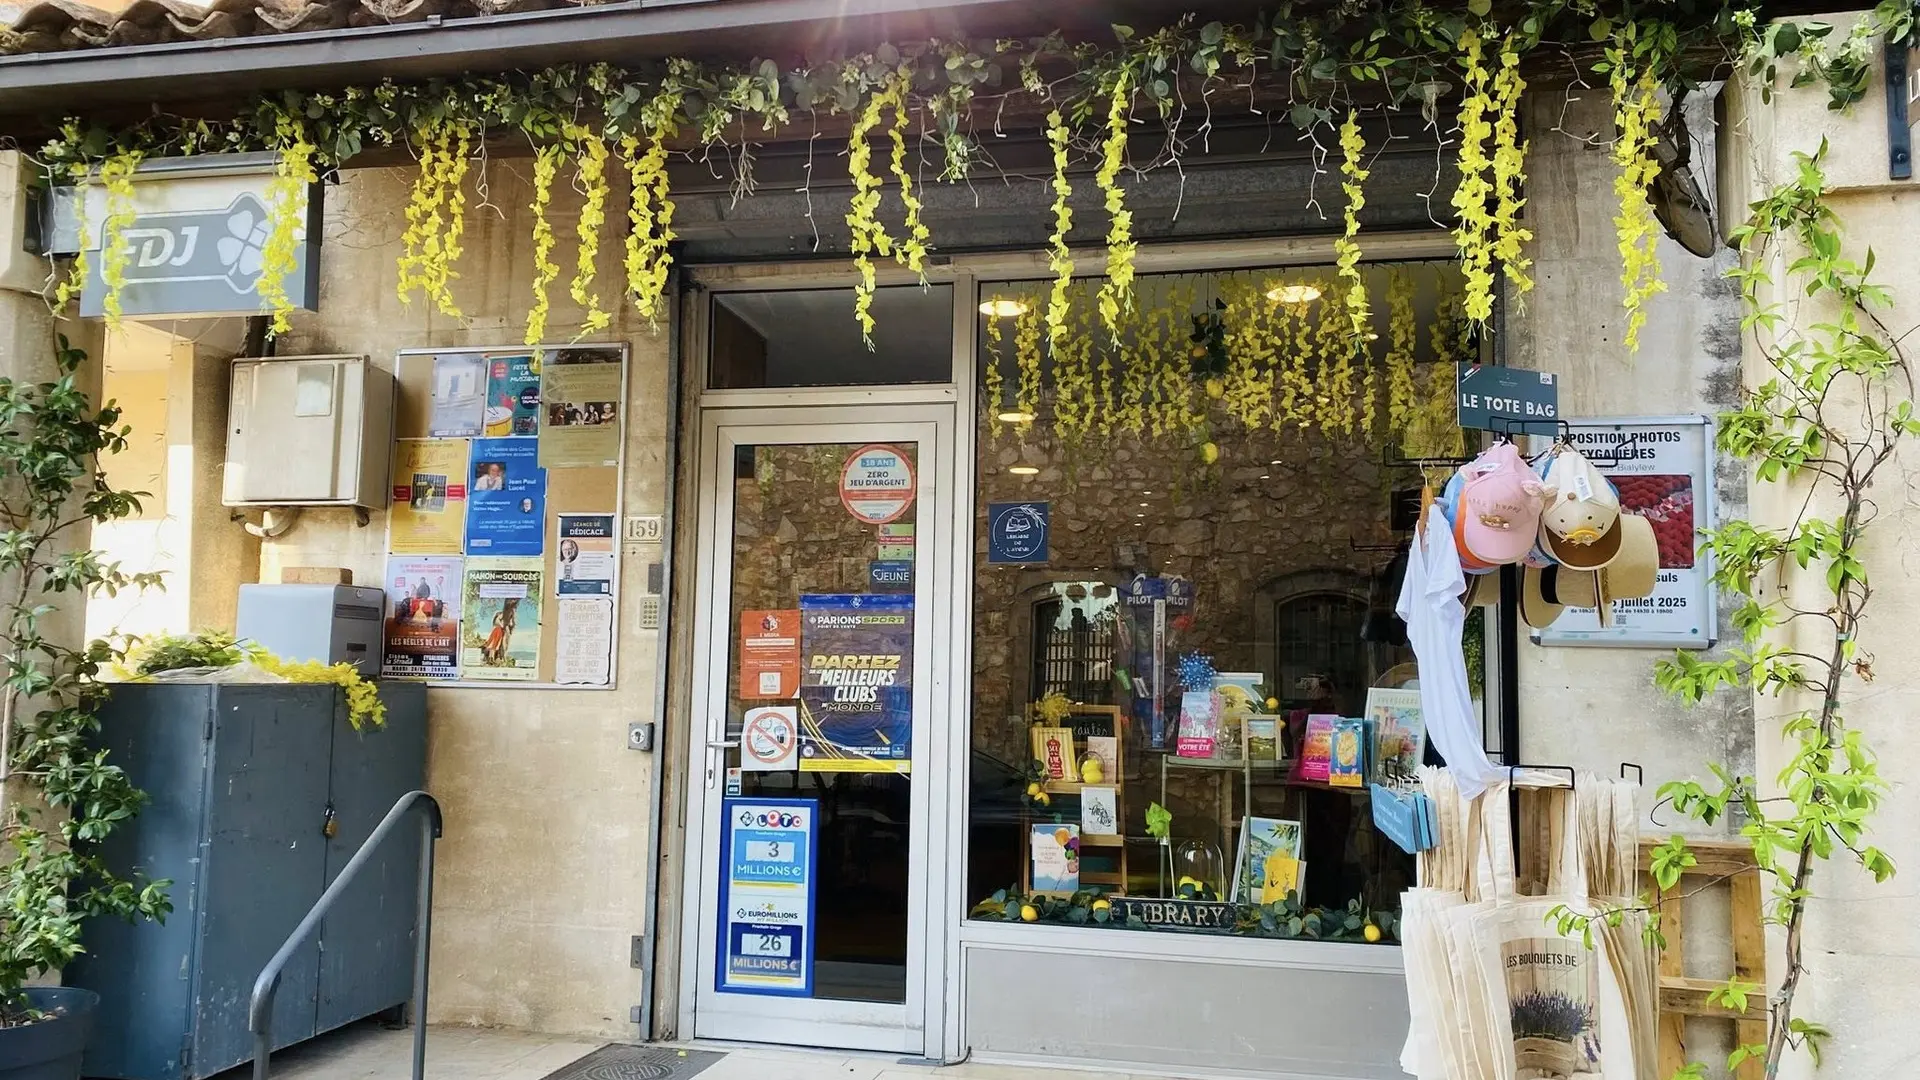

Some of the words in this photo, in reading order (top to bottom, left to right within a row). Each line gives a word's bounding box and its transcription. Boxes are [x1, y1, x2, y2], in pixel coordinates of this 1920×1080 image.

[1463, 393, 1478, 408] LE
[1484, 396, 1520, 413] TOTE
[1526, 401, 1555, 417] BAG
[1553, 433, 1626, 444] EXPOSITION
[1631, 431, 1681, 443] PHOTOS
[1580, 447, 1656, 459] EYGALIÈRES
[569, 528, 604, 536] DÉDICACE
[629, 520, 658, 537] 159
[469, 572, 496, 580] MANON
[502, 572, 539, 581] SOURCES
[1127, 595, 1152, 605] PILOT
[1166, 596, 1188, 606] PILOT
[1620, 597, 1654, 608] juillet
[1658, 597, 1687, 607] 2025
[817, 616, 861, 624] PARIONS
[862, 616, 904, 624] SPORT
[391, 637, 402, 646] LES
[425, 638, 433, 646] DE
[434, 638, 450, 647] L'ART
[810, 655, 900, 669] PARIEZ
[819, 669, 897, 686] MEILLEURS
[834, 686, 878, 703] CLUBS
[827, 702, 883, 711] MONDE
[1200, 742, 1210, 751] ÉTÉ
[757, 810, 802, 828] LOTO
[768, 841, 779, 858] 3
[737, 865, 790, 876] MILLIONS
[791, 867, 801, 876] €
[748, 911, 798, 919] EUROMILLIONS
[1125, 902, 1225, 926] LIBRARY
[759, 934, 782, 951] 26
[733, 957, 788, 970] MILLIONS
[789, 960, 797, 970] €
[1506, 955, 1517, 968] LES
[1519, 953, 1562, 965] BOUQUETS
[1565, 955, 1577, 967] DE
